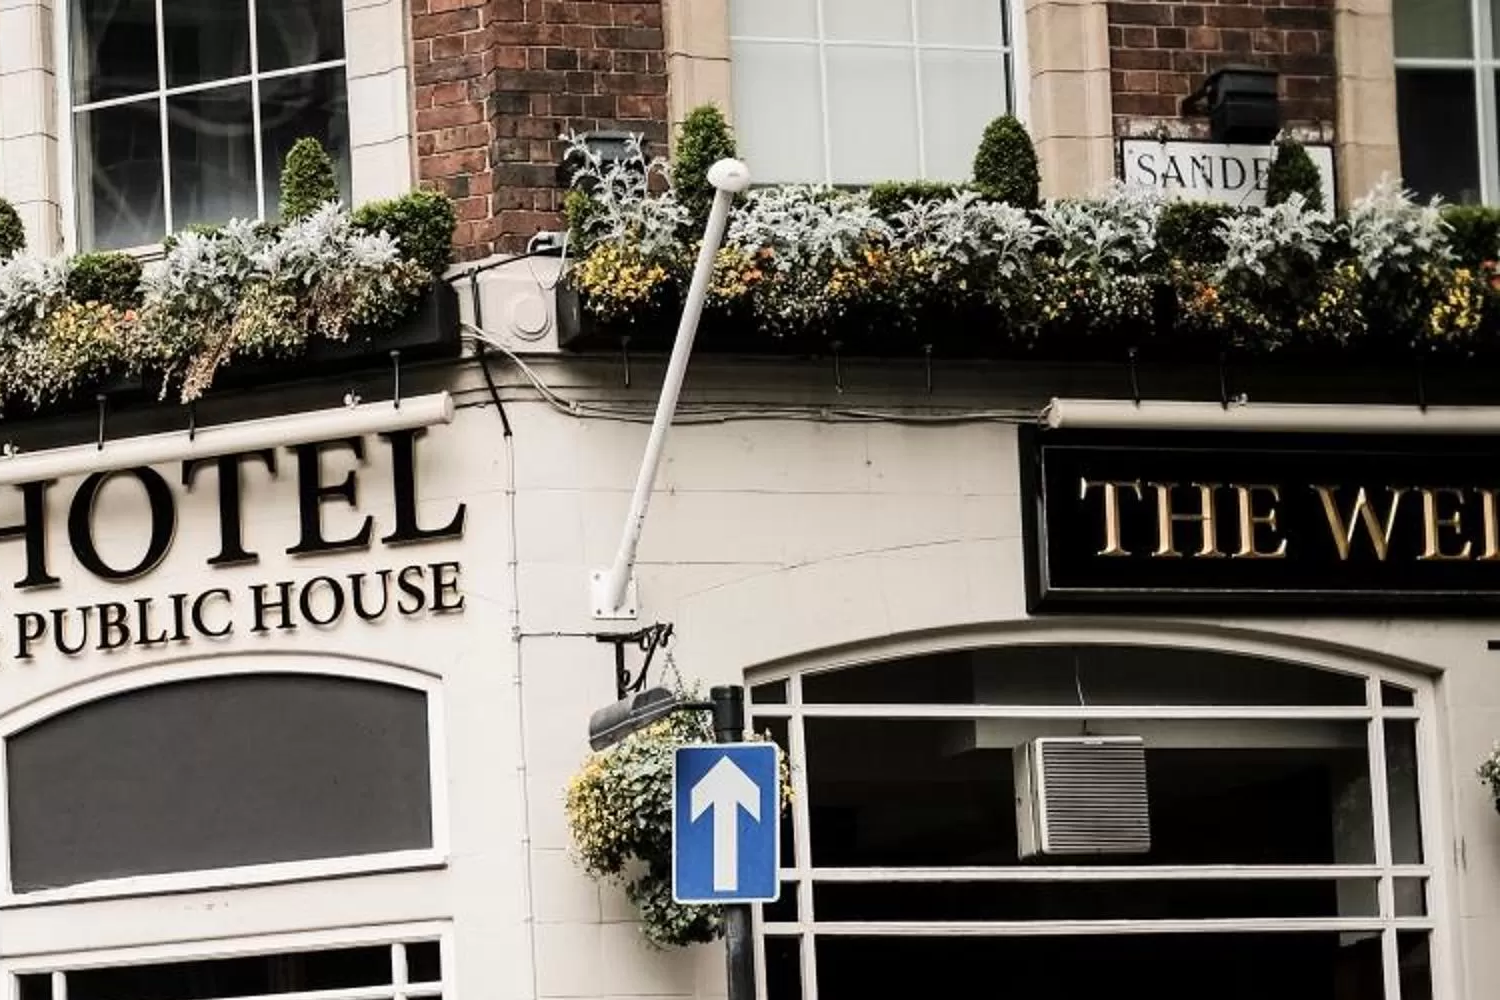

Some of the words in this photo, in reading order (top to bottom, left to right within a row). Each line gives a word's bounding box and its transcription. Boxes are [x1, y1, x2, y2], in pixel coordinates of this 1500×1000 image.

[1137, 153, 1270, 191] SANDE
[1080, 477, 1288, 558] THE
[14, 588, 234, 660] PUBLIC
[249, 562, 466, 632] HOUSE
